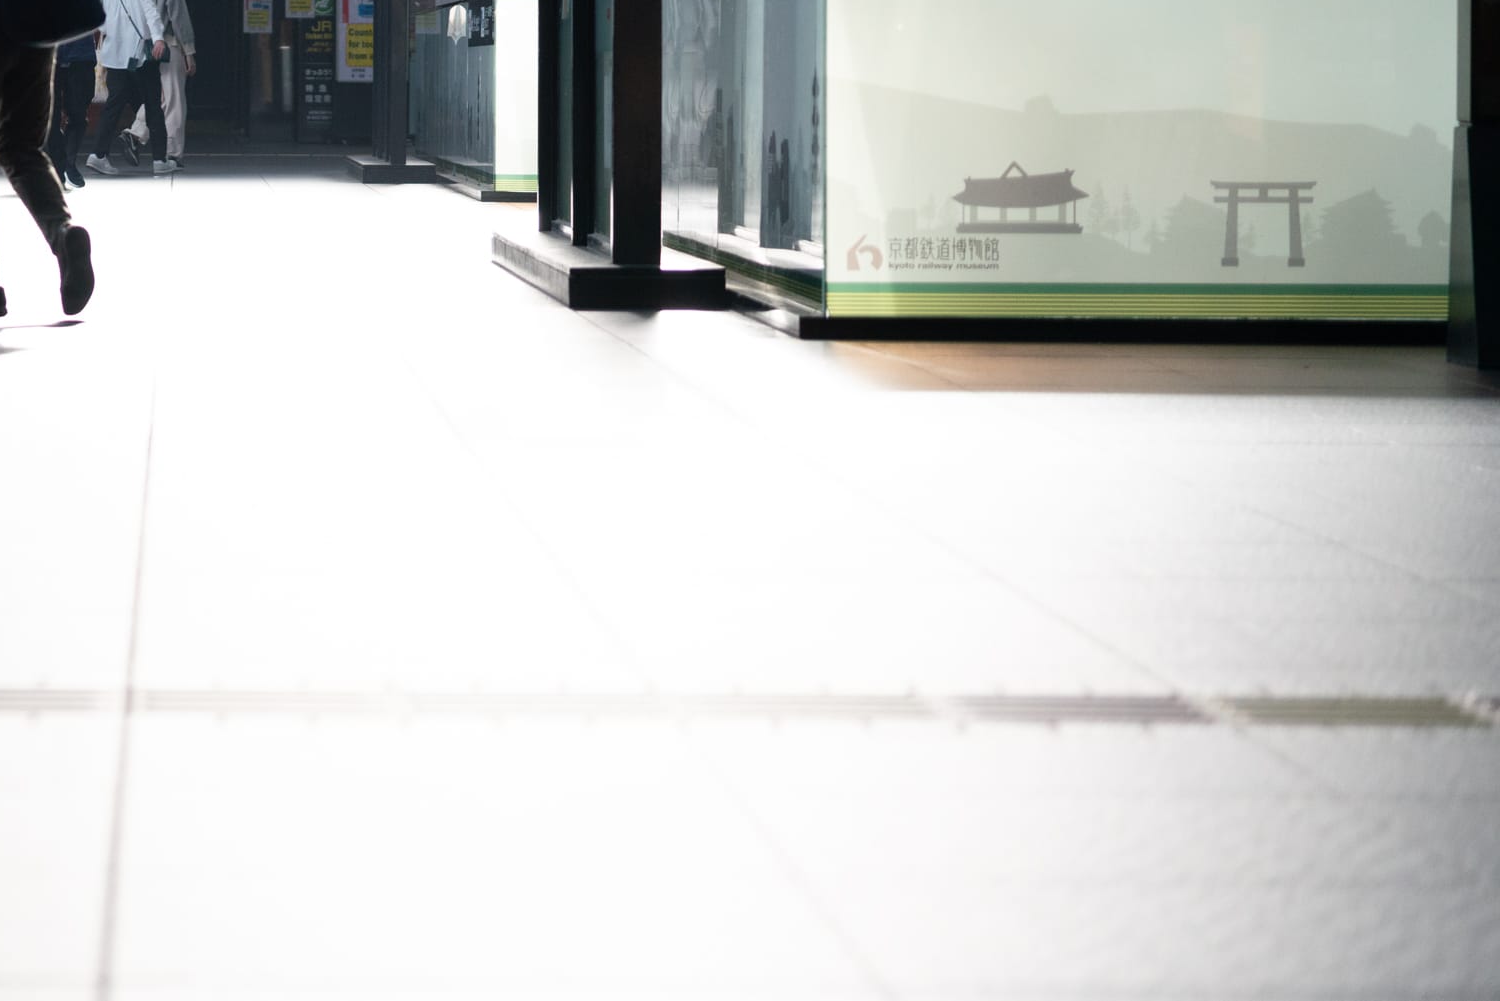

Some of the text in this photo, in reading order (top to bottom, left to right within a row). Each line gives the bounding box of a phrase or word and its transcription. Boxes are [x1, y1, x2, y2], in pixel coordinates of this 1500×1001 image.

[888, 237, 1000, 262] 京都鉄道博物館
[888, 261, 1000, 271] kyoto railway museum
